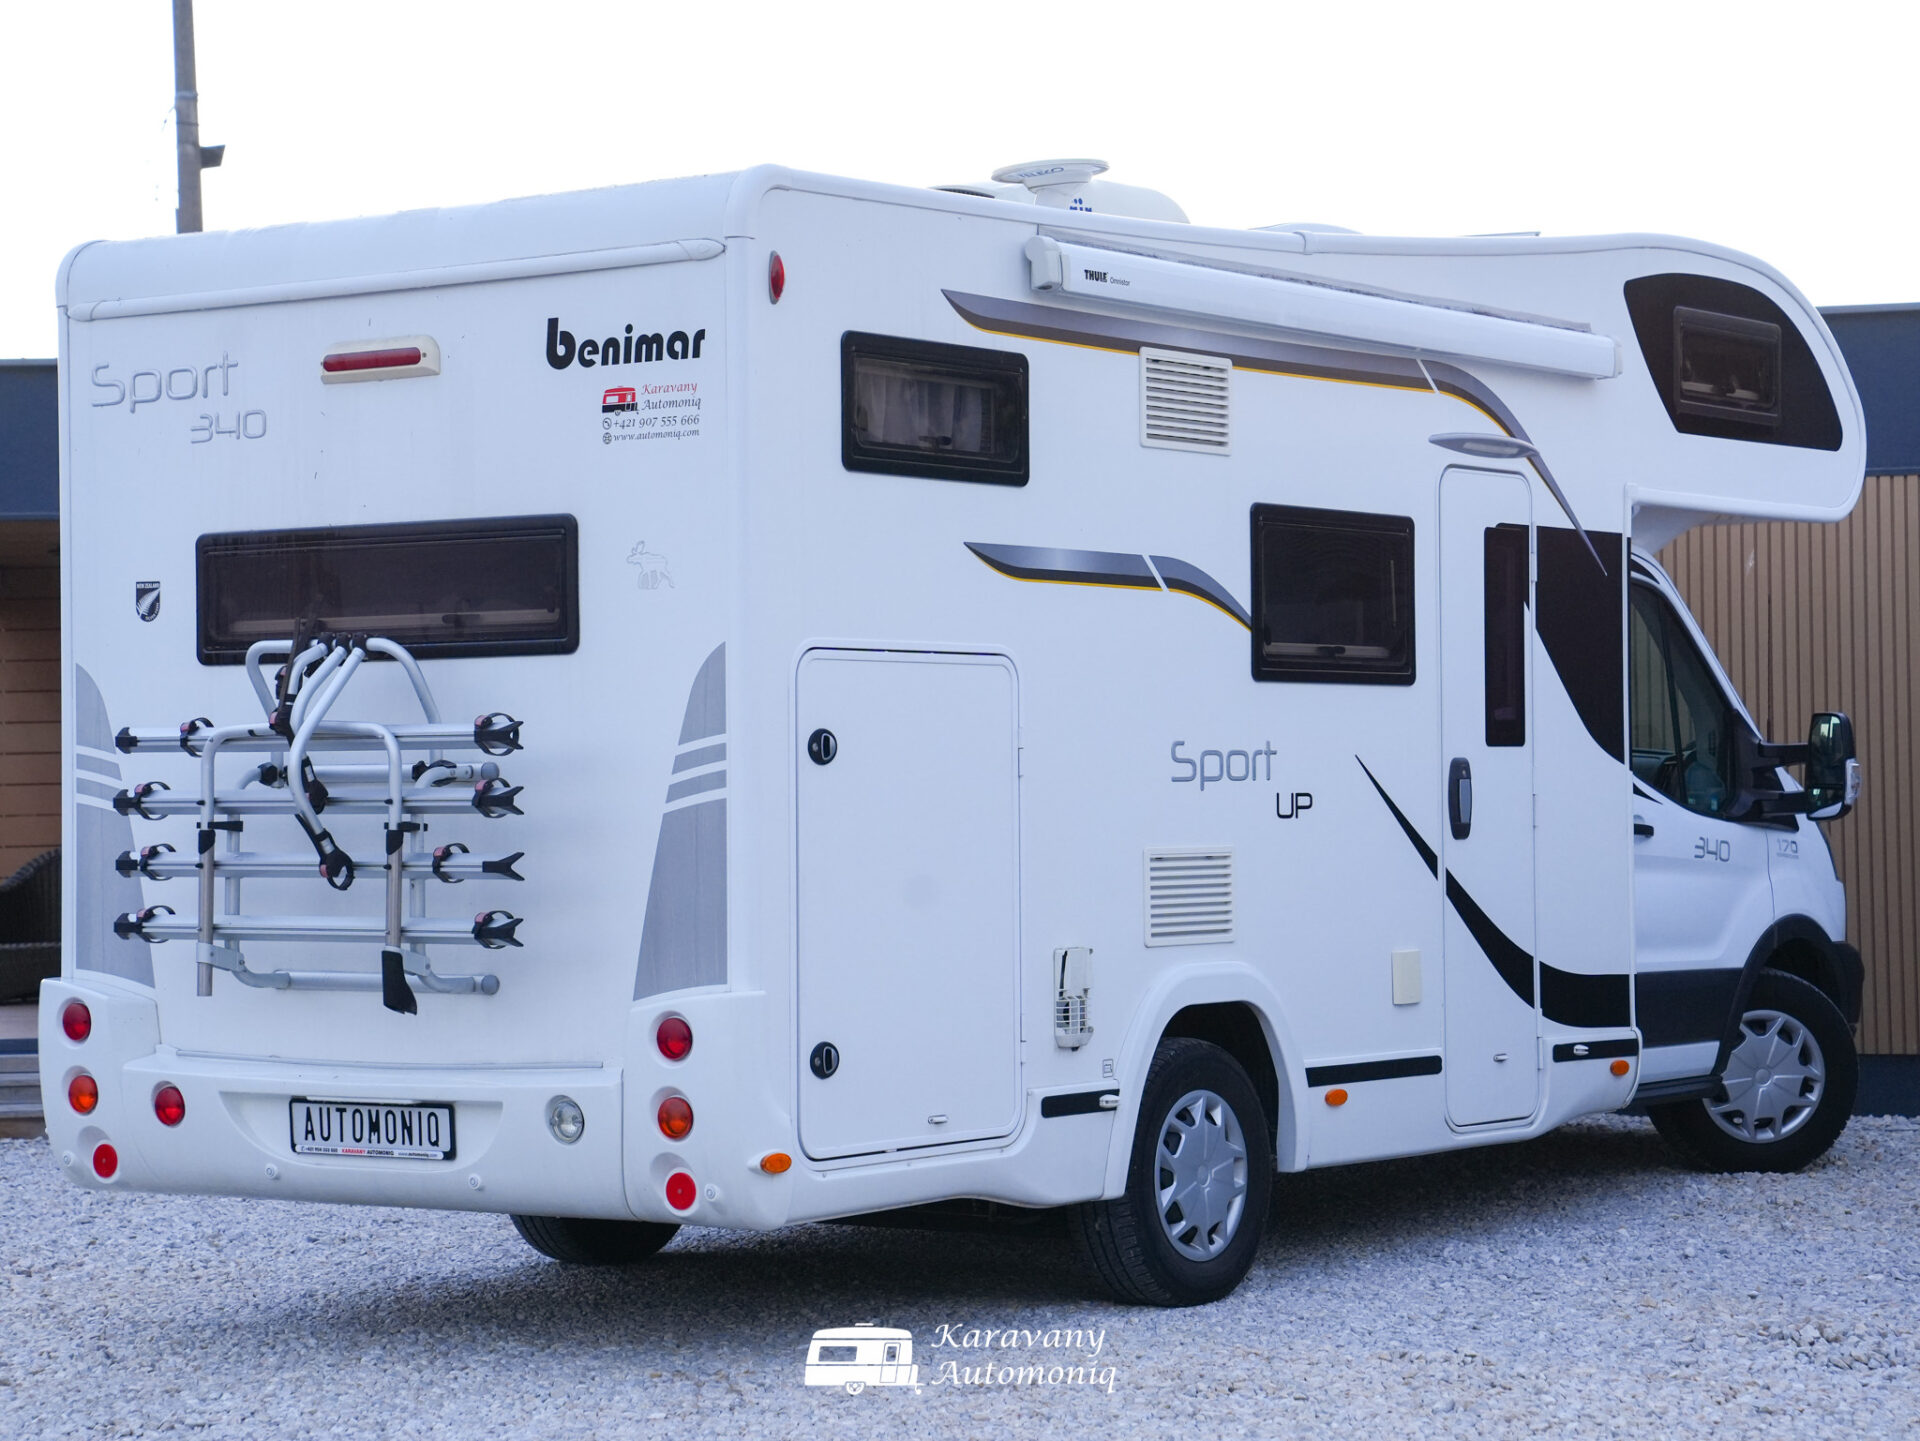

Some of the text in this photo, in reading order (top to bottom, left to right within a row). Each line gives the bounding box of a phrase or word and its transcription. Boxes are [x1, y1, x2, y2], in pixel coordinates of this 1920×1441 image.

[1084, 269, 1108, 283] THULE
[546, 317, 706, 371] benimar
[91, 350, 239, 414] Sport
[641, 382, 698, 396] Karavany
[641, 397, 702, 411] Automoniq
[190, 409, 267, 444] 340
[613, 414, 700, 430] +421 907 555 666
[613, 428, 700, 441] www.automoniq.com
[1170, 740, 1278, 792] Sport
[1276, 792, 1313, 819] UP
[1693, 836, 1731, 862] 340
[304, 1106, 440, 1148] AUTOMONIQ
